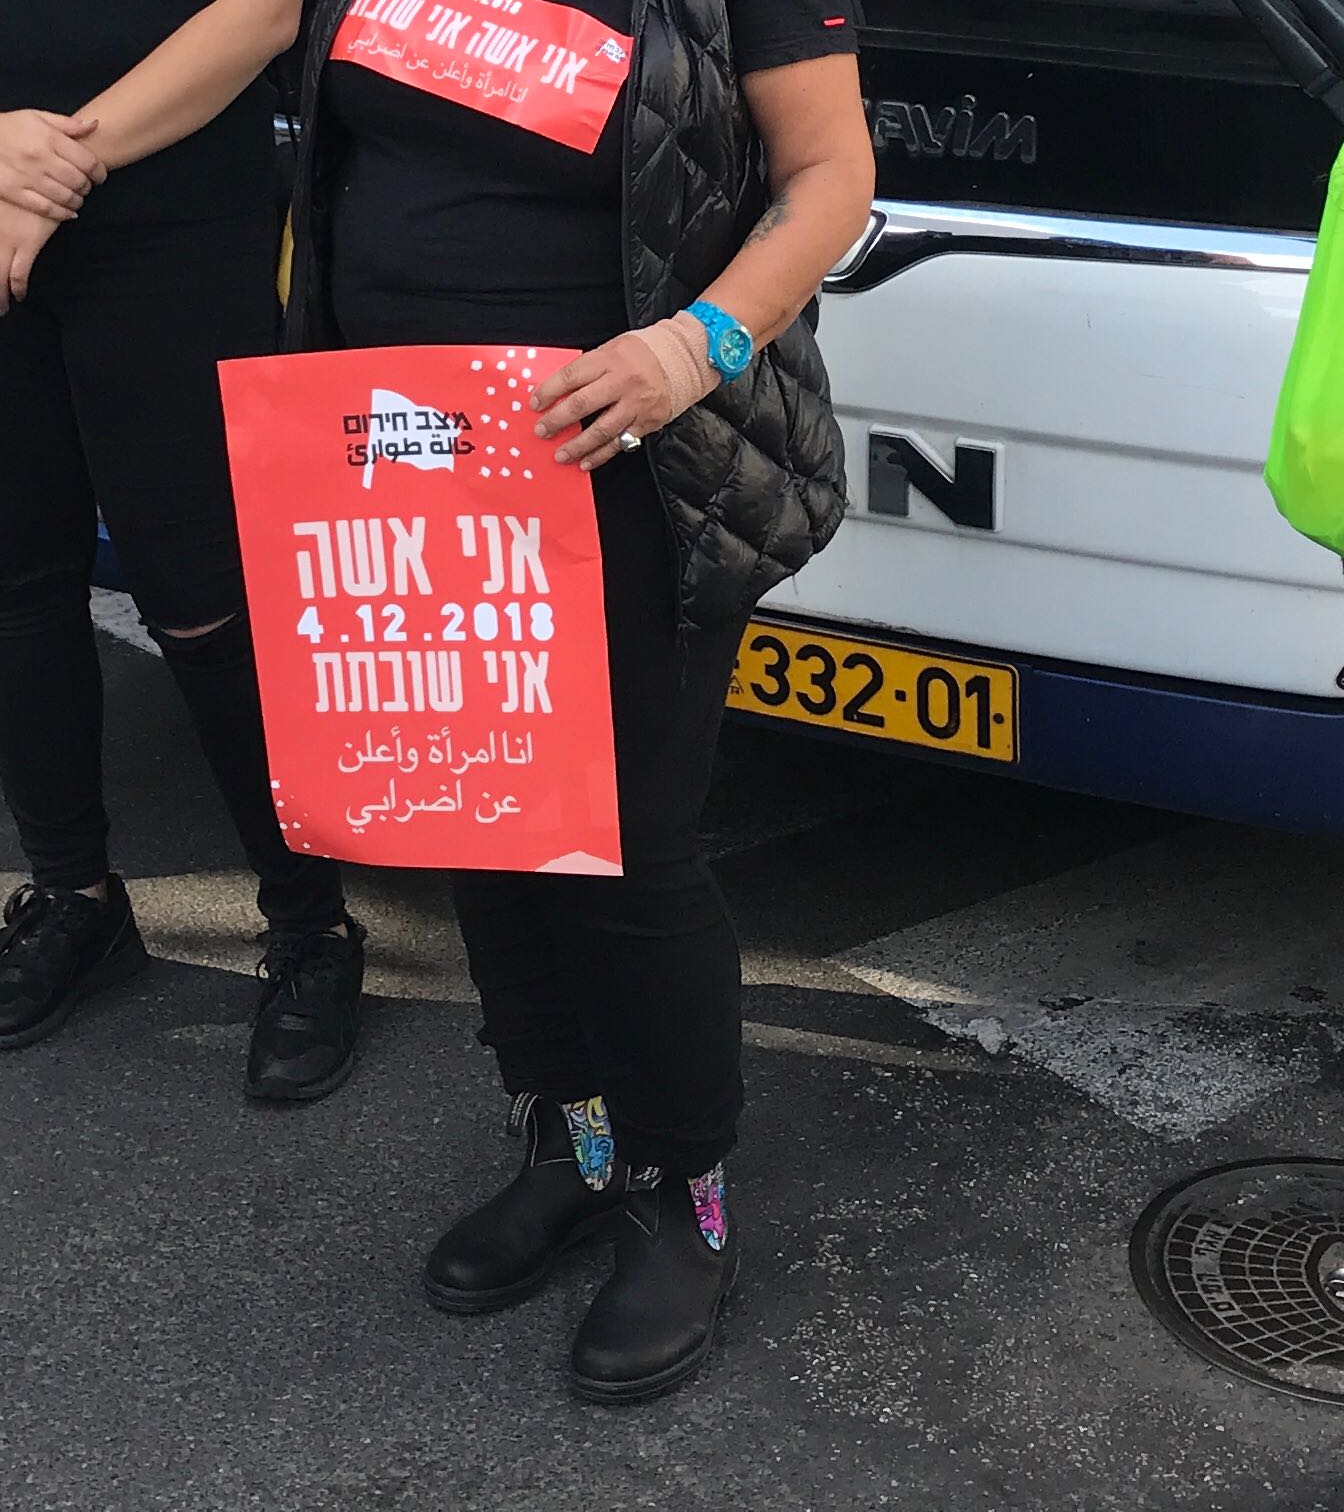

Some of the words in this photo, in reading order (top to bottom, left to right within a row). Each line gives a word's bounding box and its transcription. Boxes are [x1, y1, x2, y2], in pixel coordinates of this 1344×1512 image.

[426, 4, 473, 50] אני
[465, 20, 539, 74] אשה
[540, 43, 590, 95] אני
[342, 410, 409, 435] חירום
[413, 409, 474, 433] מצב
[428, 432, 477, 456] حالة
[345, 434, 423, 468] طوارئ
[292, 515, 434, 599] אשה
[455, 513, 552, 595] אני
[295, 600, 556, 644] 4.12.2018
[310, 649, 465, 714] שובתת
[482, 649, 554, 715] אני
[337, 724, 420, 775] وأعلن
[426, 724, 496, 776] امرأة
[501, 729, 534, 766] انا
[474, 788, 522, 824] عن
